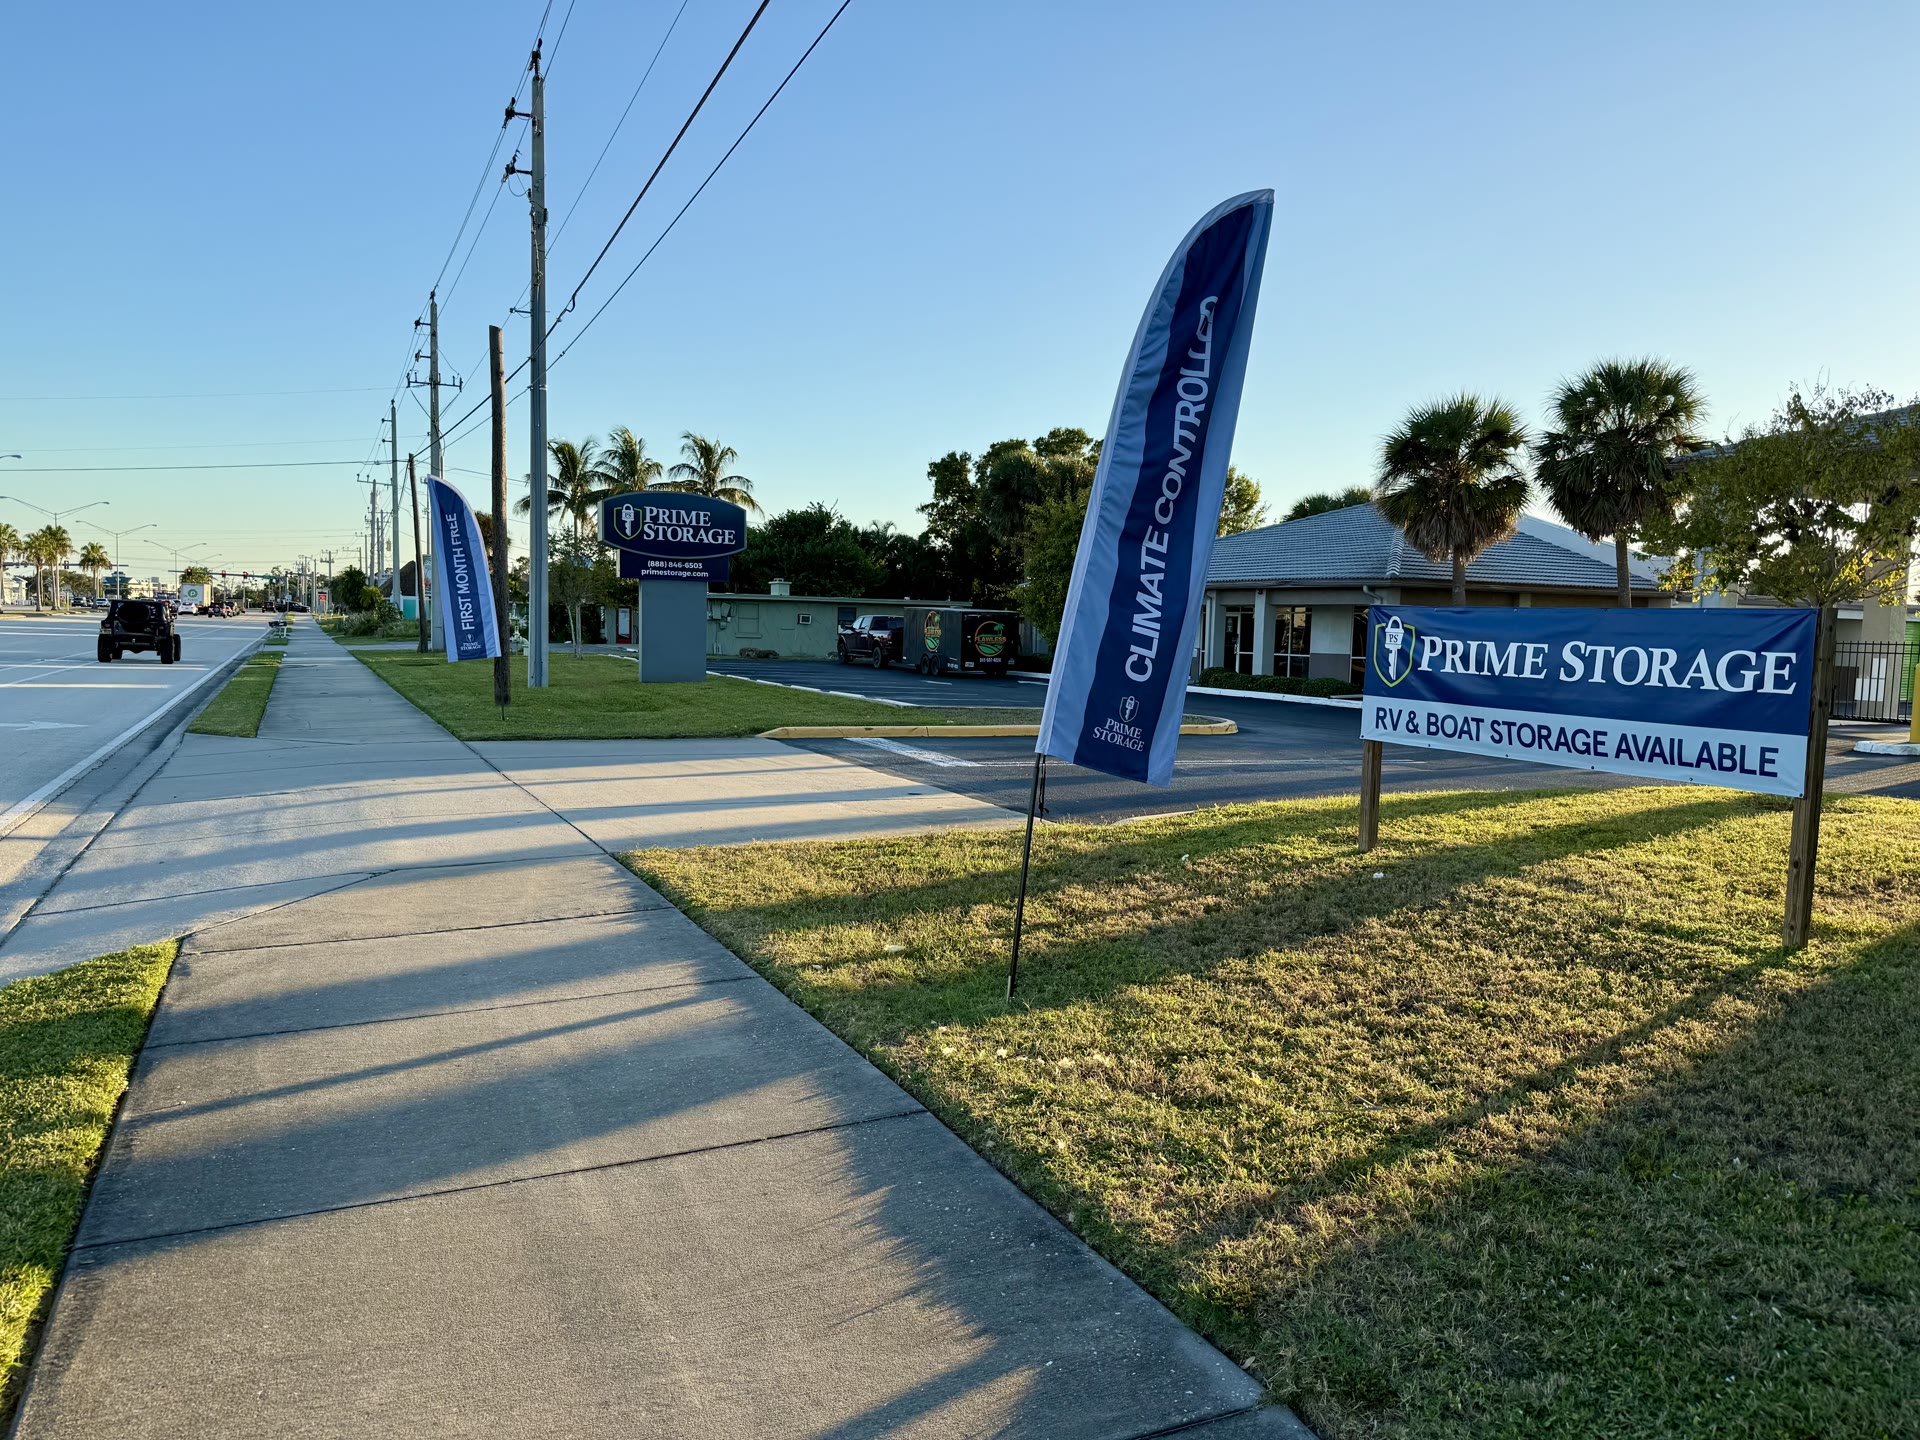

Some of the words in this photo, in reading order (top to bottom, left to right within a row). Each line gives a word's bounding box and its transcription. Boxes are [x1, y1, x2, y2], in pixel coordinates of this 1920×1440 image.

[445, 512, 462, 546] FREE
[644, 506, 711, 527] PRIME
[643, 523, 736, 545] STORAGE
[451, 547, 470, 595] MONTH
[641, 568, 709, 578] primestorage.com
[647, 560, 668, 569] (888)
[668, 561, 703, 569] 846-6503
[458, 596, 475, 630] FIRST
[1124, 526, 1170, 682] CLIMATE
[1388, 633, 1399, 643] PS
[1417, 635, 1549, 679] PRIME
[1559, 640, 1797, 695] STORAGE
[1093, 726, 1145, 752] STORAGE
[1104, 718, 1142, 740] PRIME
[1375, 706, 1403, 731] RV
[1405, 710, 1420, 734] &
[1426, 712, 1486, 742] BOAT
[1490, 718, 1609, 758] STORAGE
[1614, 733, 1780, 778] AVAILABLE
